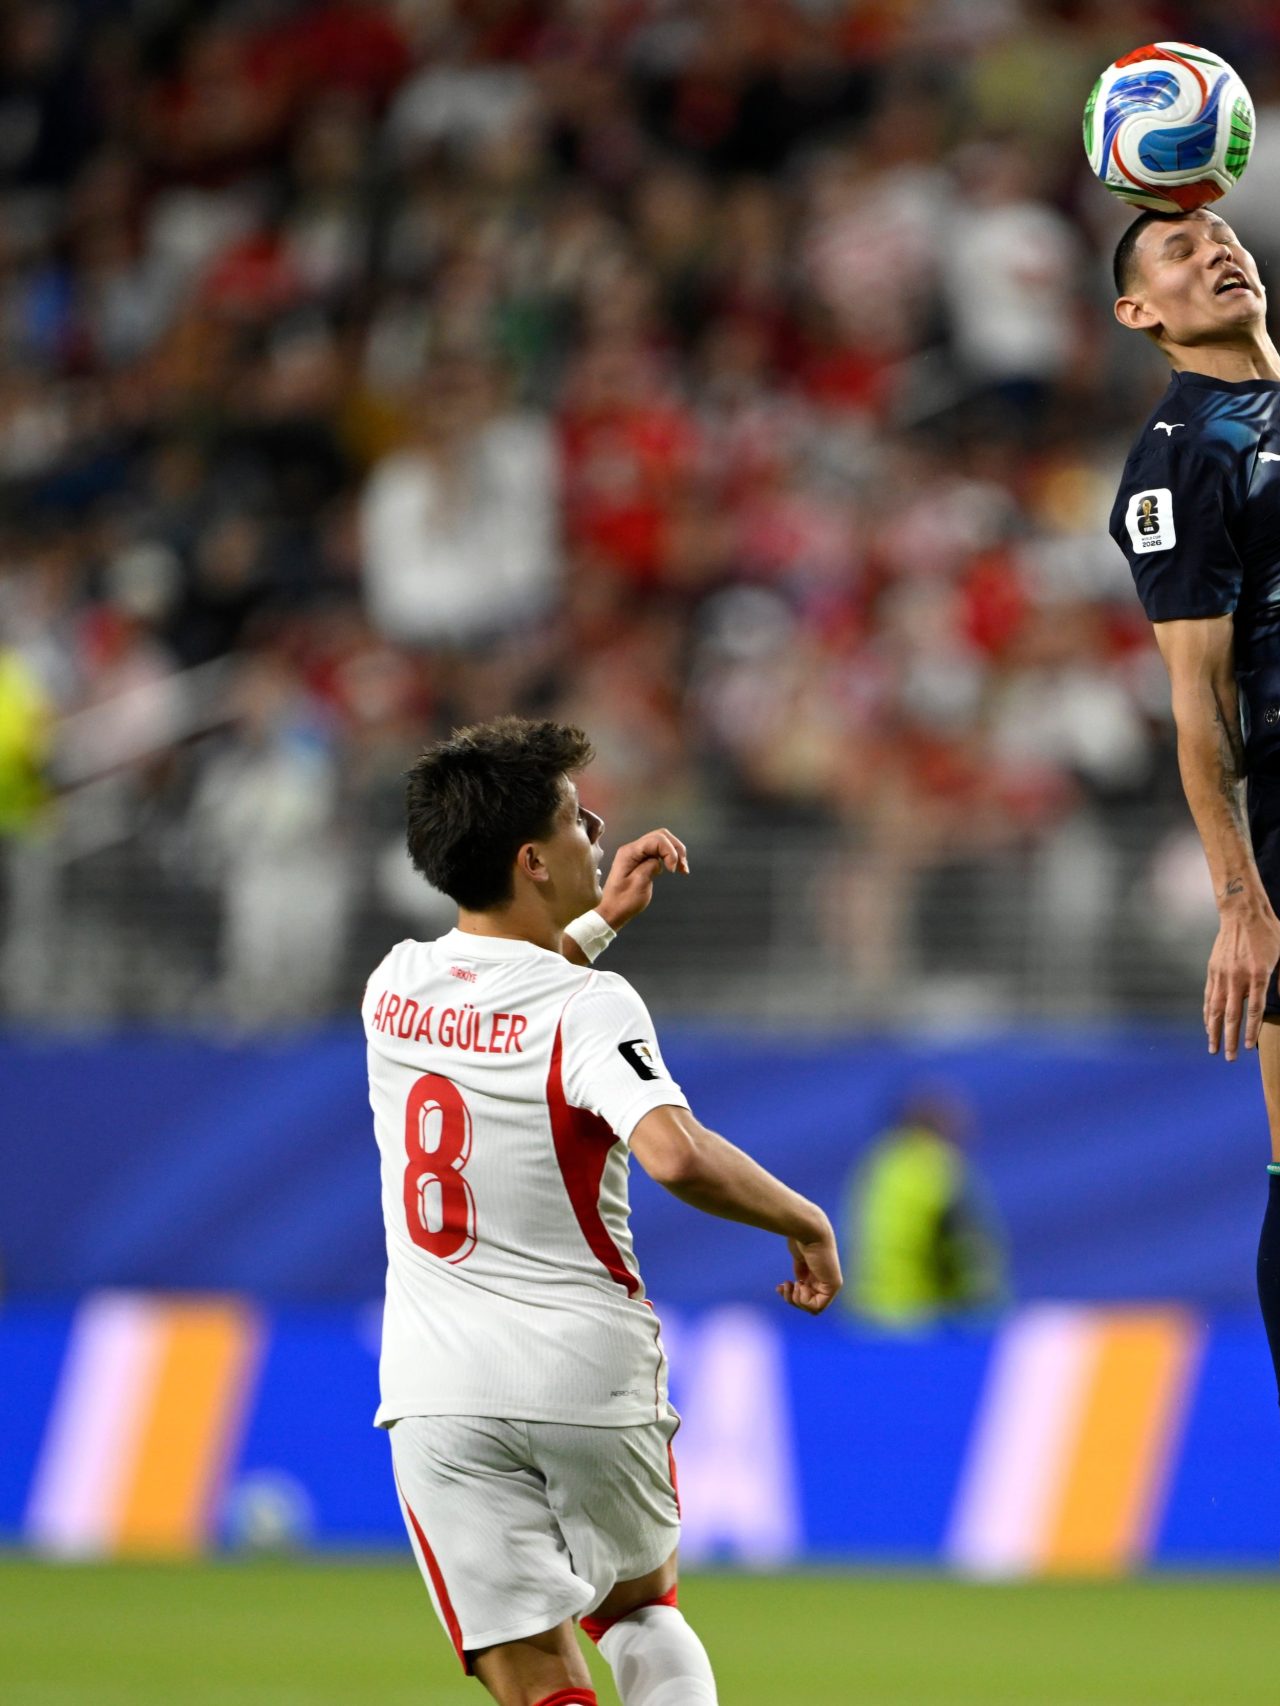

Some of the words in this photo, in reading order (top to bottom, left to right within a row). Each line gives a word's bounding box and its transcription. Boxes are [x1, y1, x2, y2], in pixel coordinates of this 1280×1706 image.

[1142, 540, 1162, 548] 2026
[371, 990, 434, 1045] ARDA
[438, 1003, 528, 1053] GÜLER
[404, 1073, 477, 1265] 8
